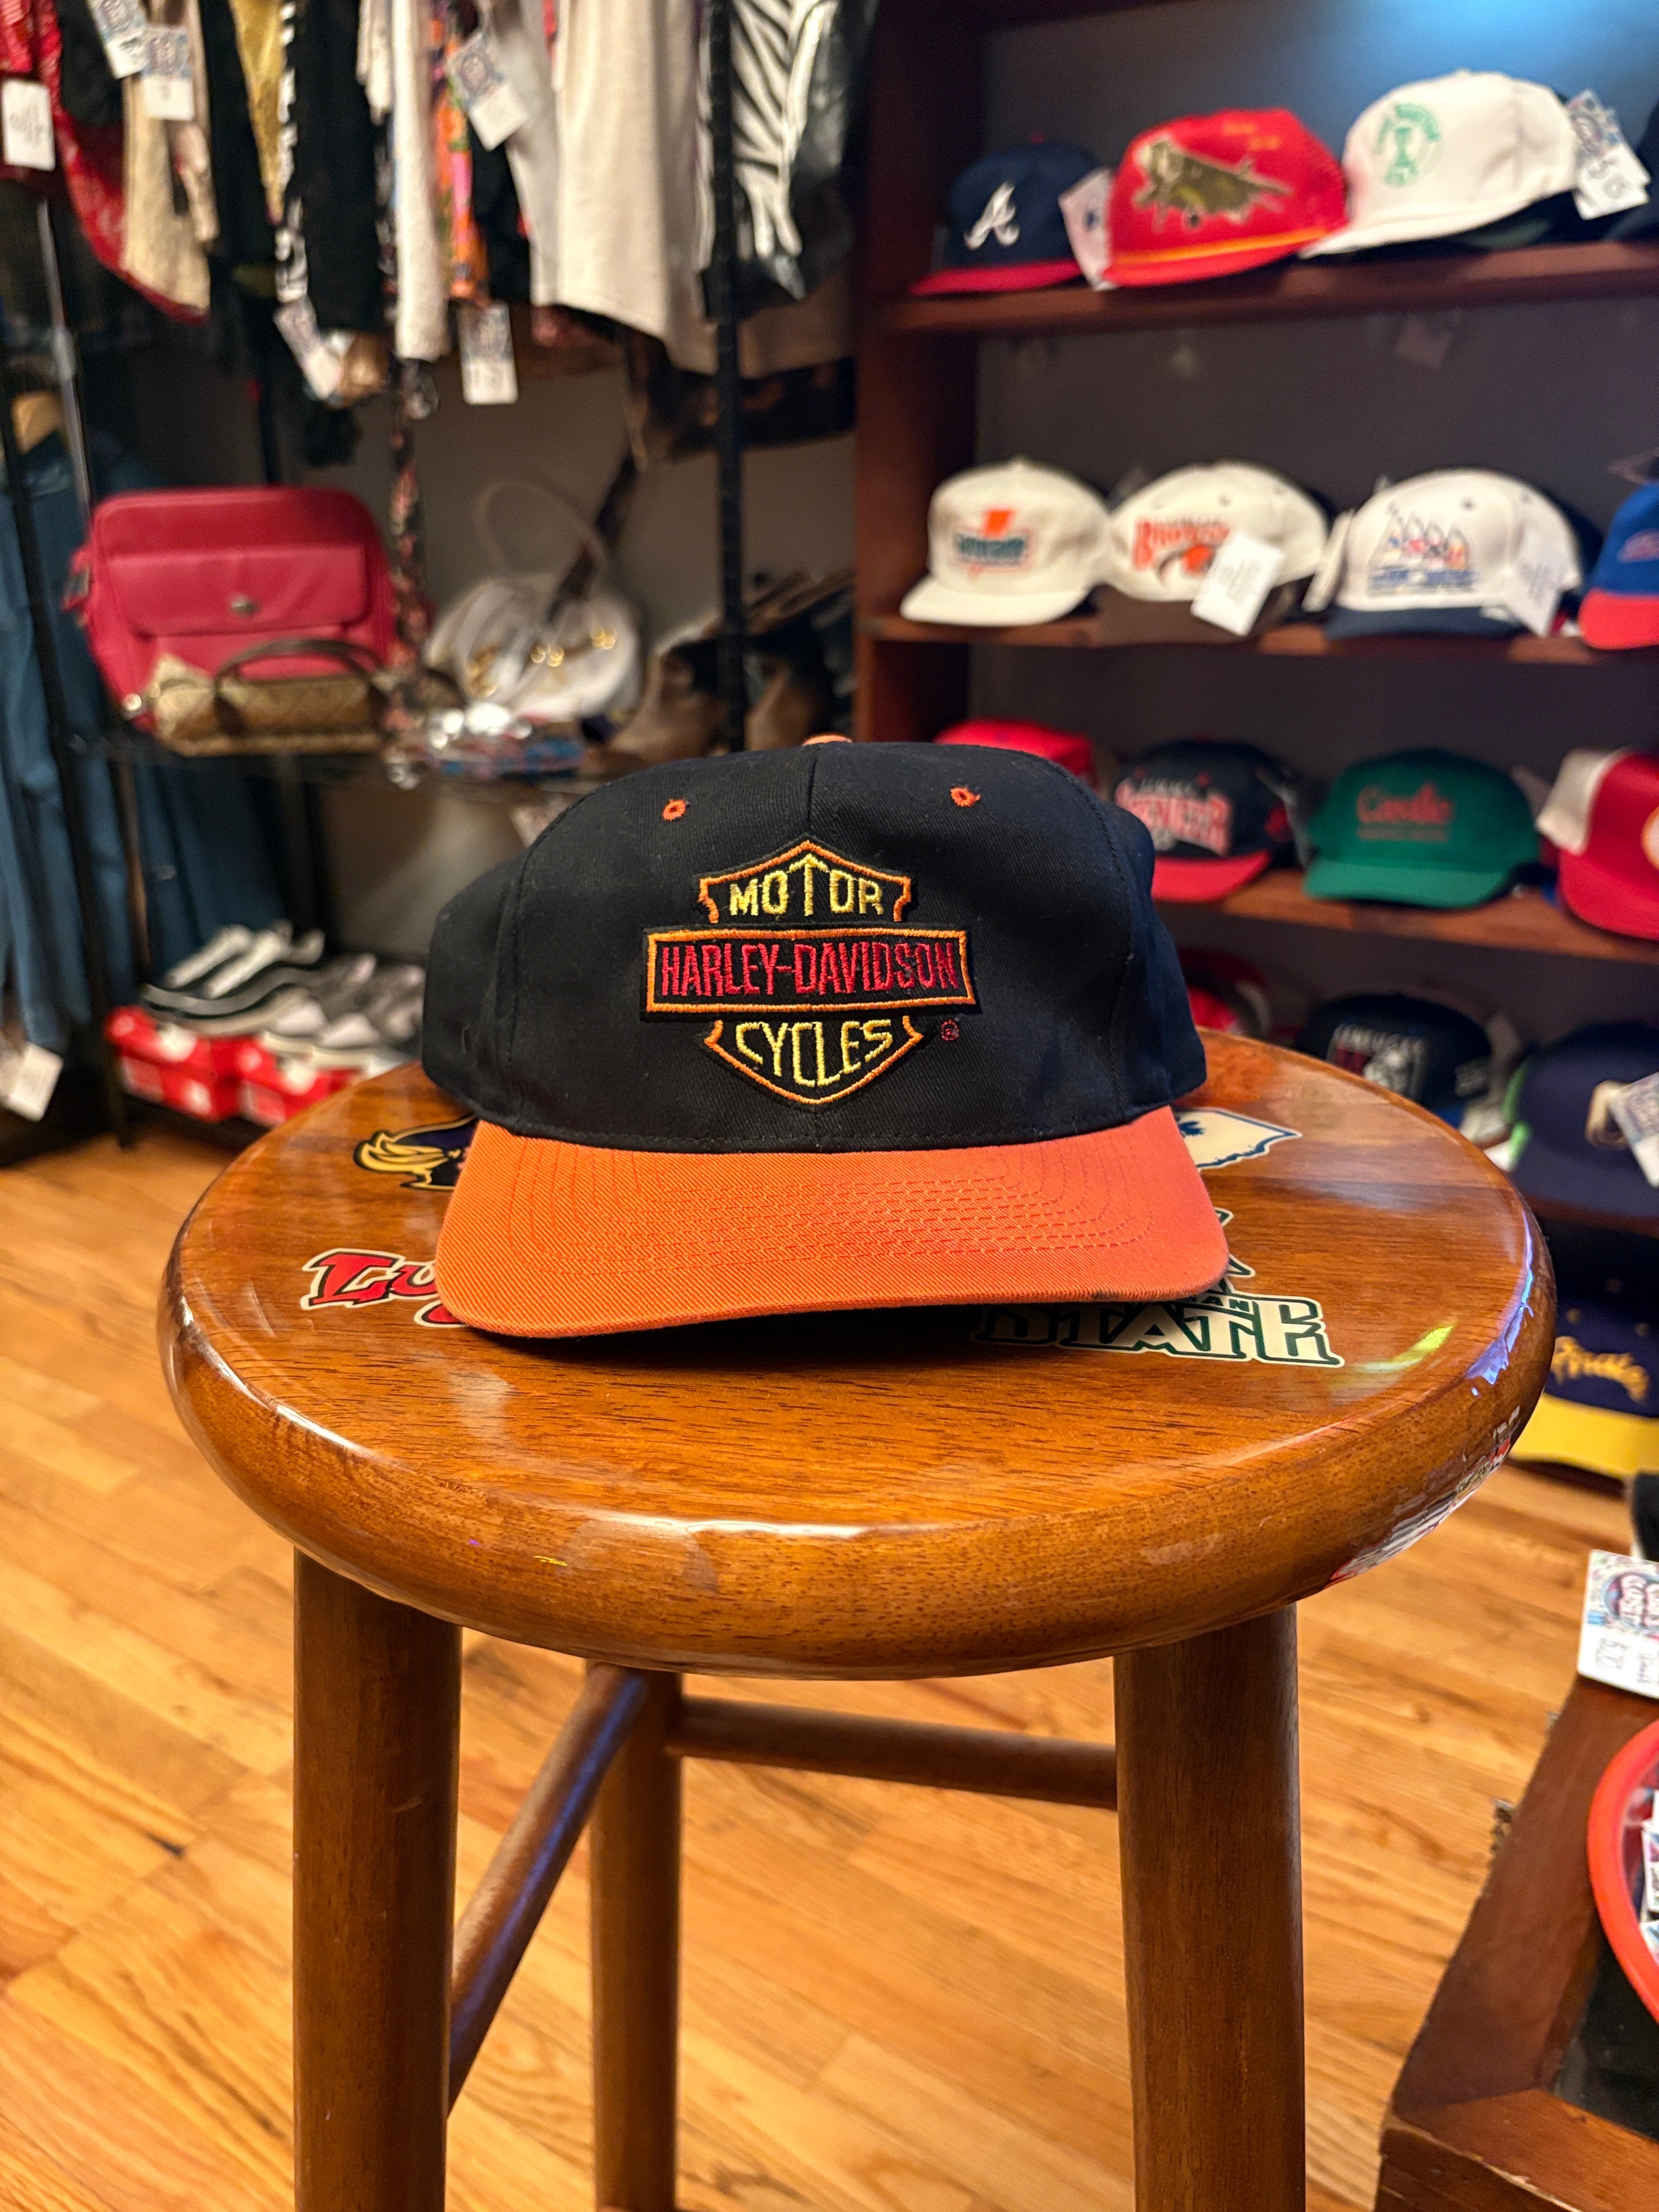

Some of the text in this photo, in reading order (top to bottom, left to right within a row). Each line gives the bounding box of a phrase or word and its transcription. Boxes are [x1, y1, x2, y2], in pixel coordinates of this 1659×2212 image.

[729, 854, 884, 916] MOTOR
[661, 941, 960, 997] HARLEY-DAVIDSON
[736, 1019, 893, 1087] CYCLES
